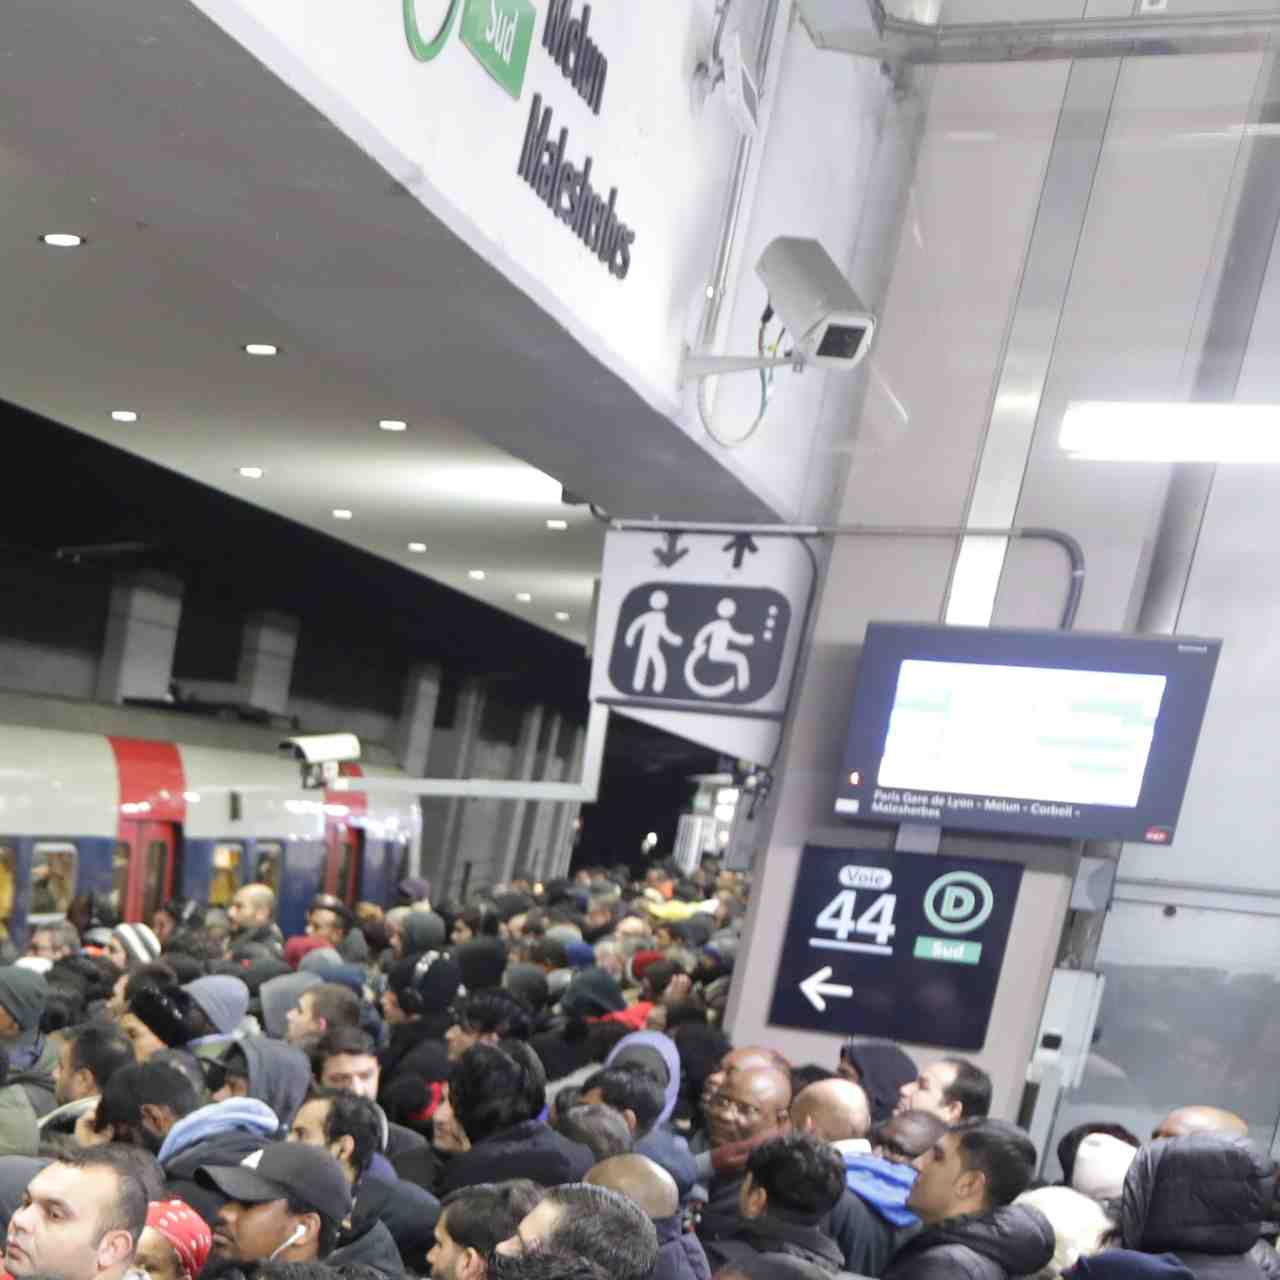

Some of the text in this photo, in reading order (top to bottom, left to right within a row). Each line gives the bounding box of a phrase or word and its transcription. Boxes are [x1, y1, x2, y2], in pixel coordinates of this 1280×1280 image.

[874, 789, 1073, 818] Paris Gare de Lyon Melun Corbeil
[847, 868, 885, 884] Voie
[940, 885, 976, 919] D
[815, 889, 897, 945] 44
[931, 942, 966, 959] Sud
